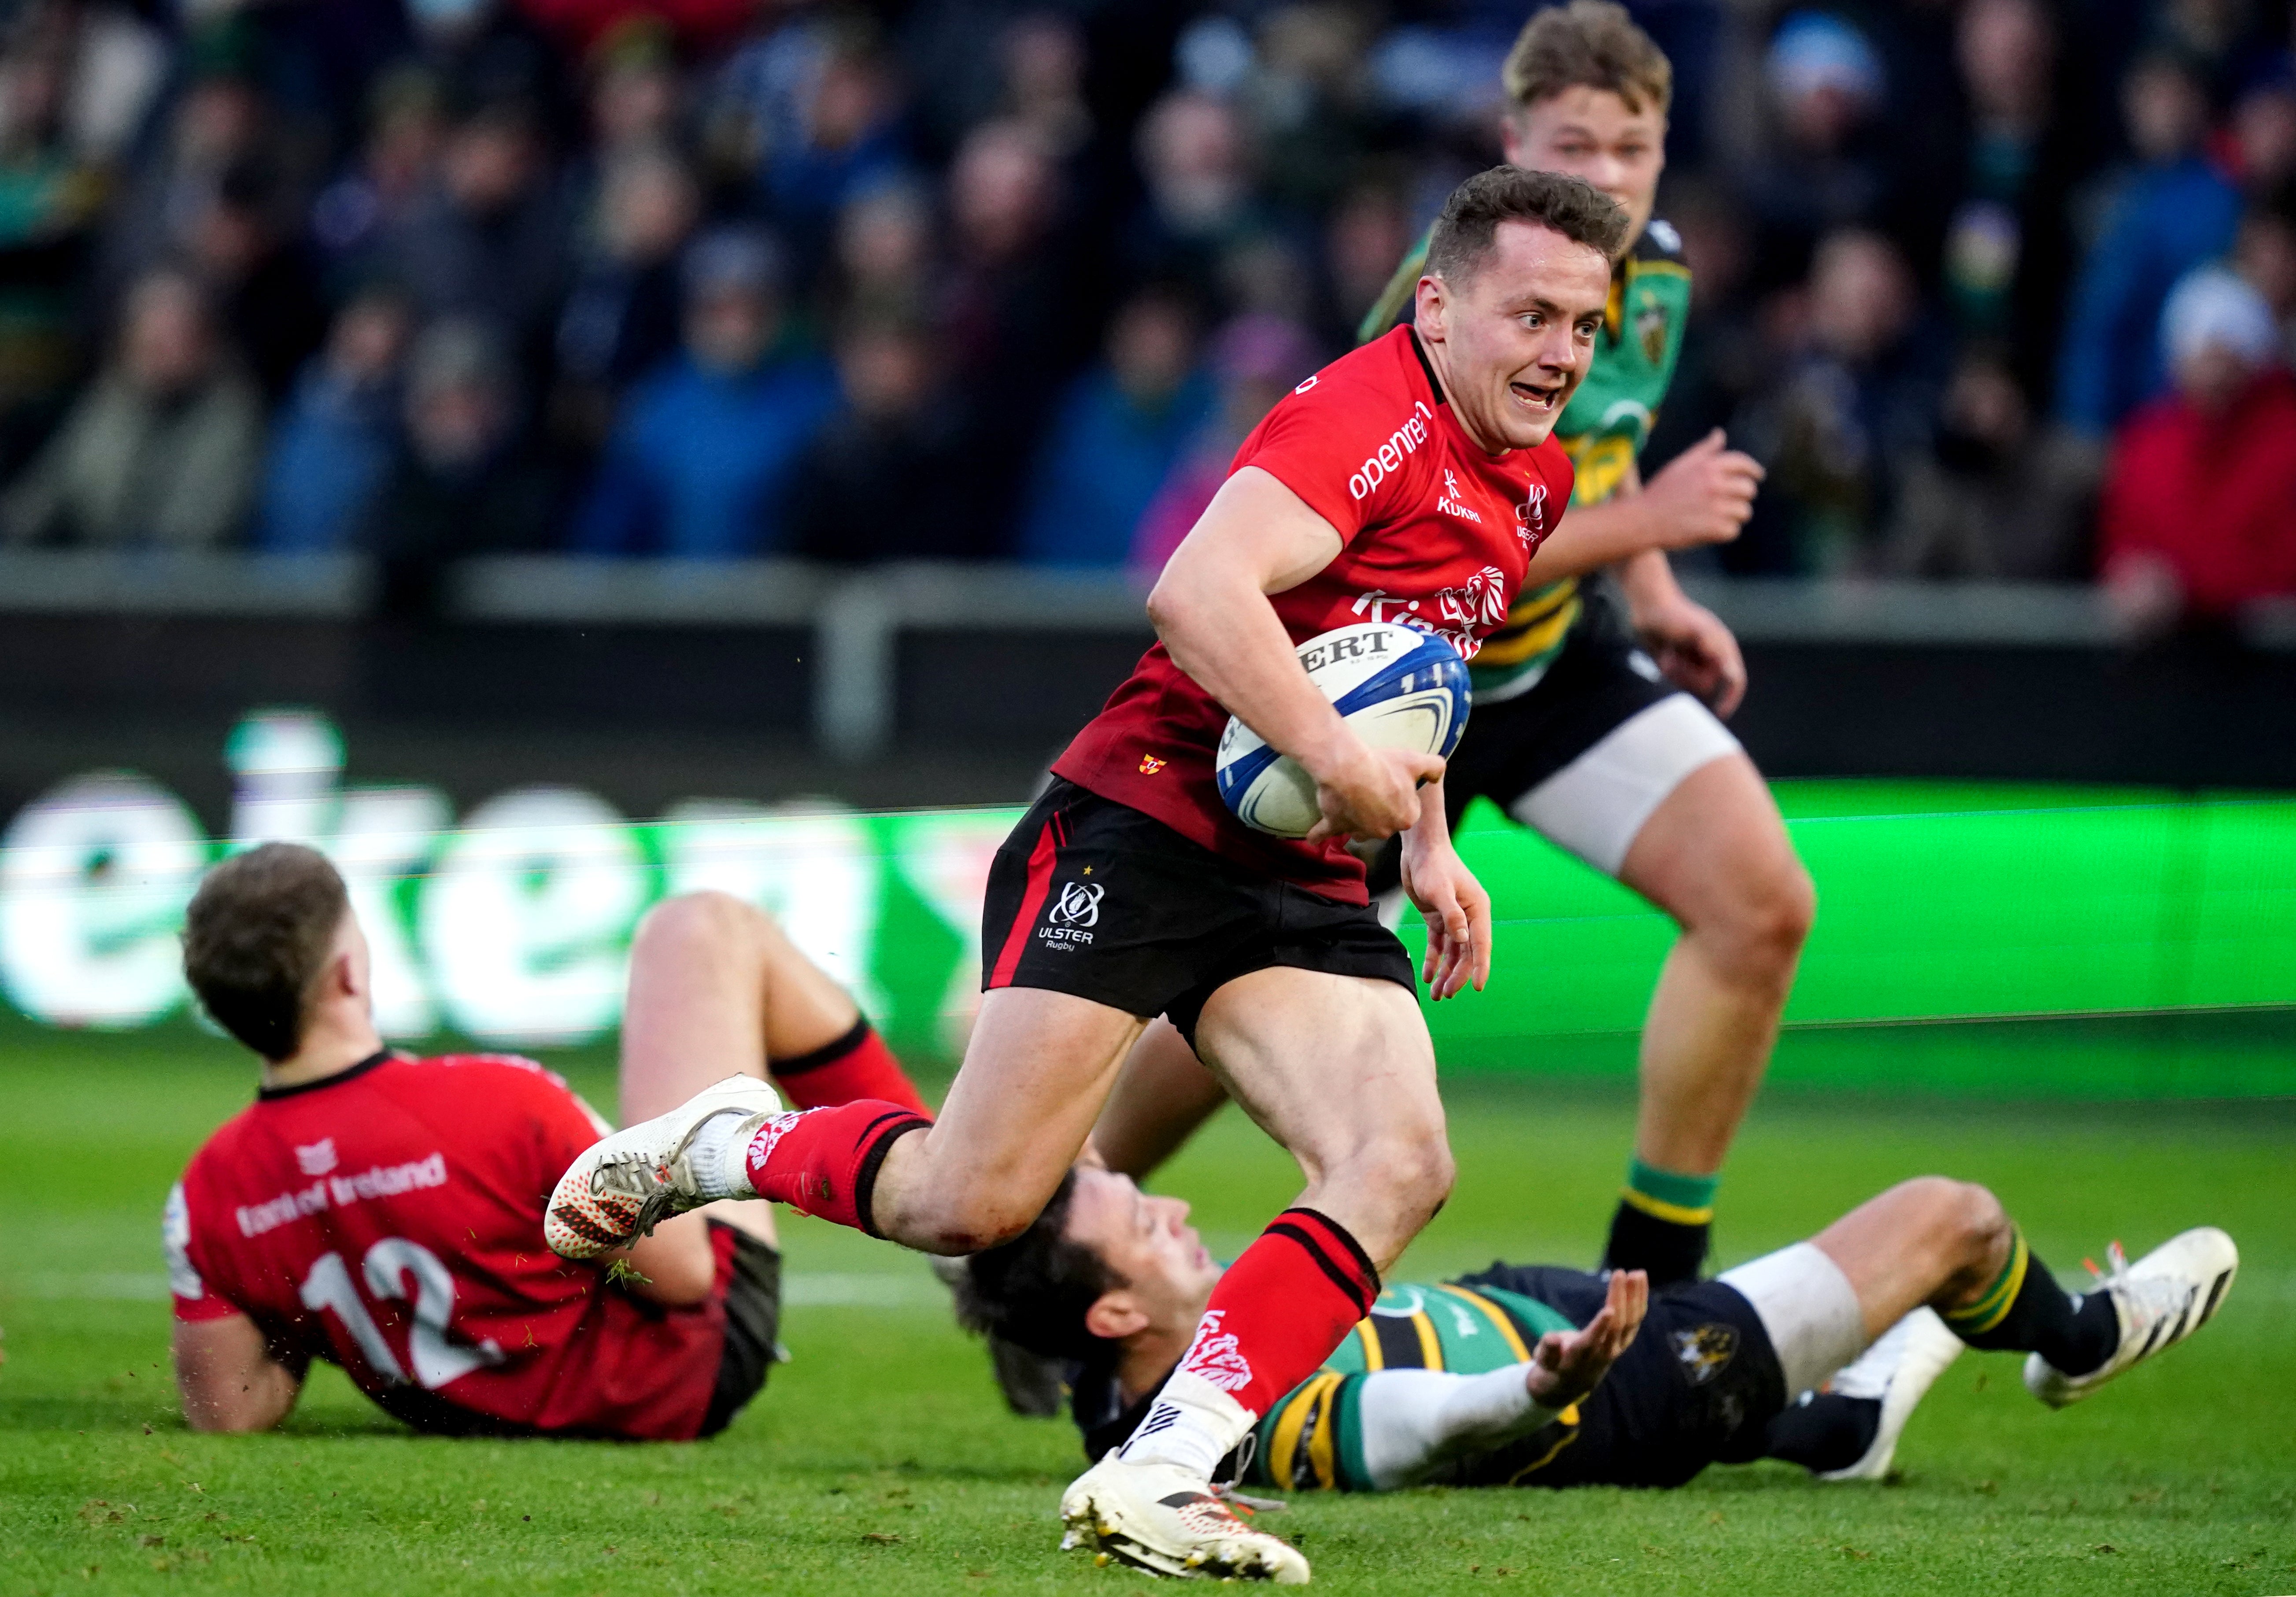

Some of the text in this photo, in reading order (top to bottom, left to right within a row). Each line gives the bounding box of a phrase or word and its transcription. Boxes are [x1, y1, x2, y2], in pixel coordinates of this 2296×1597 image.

[1437, 496, 1482, 523] KUKRI
[1298, 630, 1394, 674] ERT
[1039, 927, 1094, 945] ULSTER
[1046, 940, 1075, 952] Rugby
[298, 1237, 506, 1390] 12
